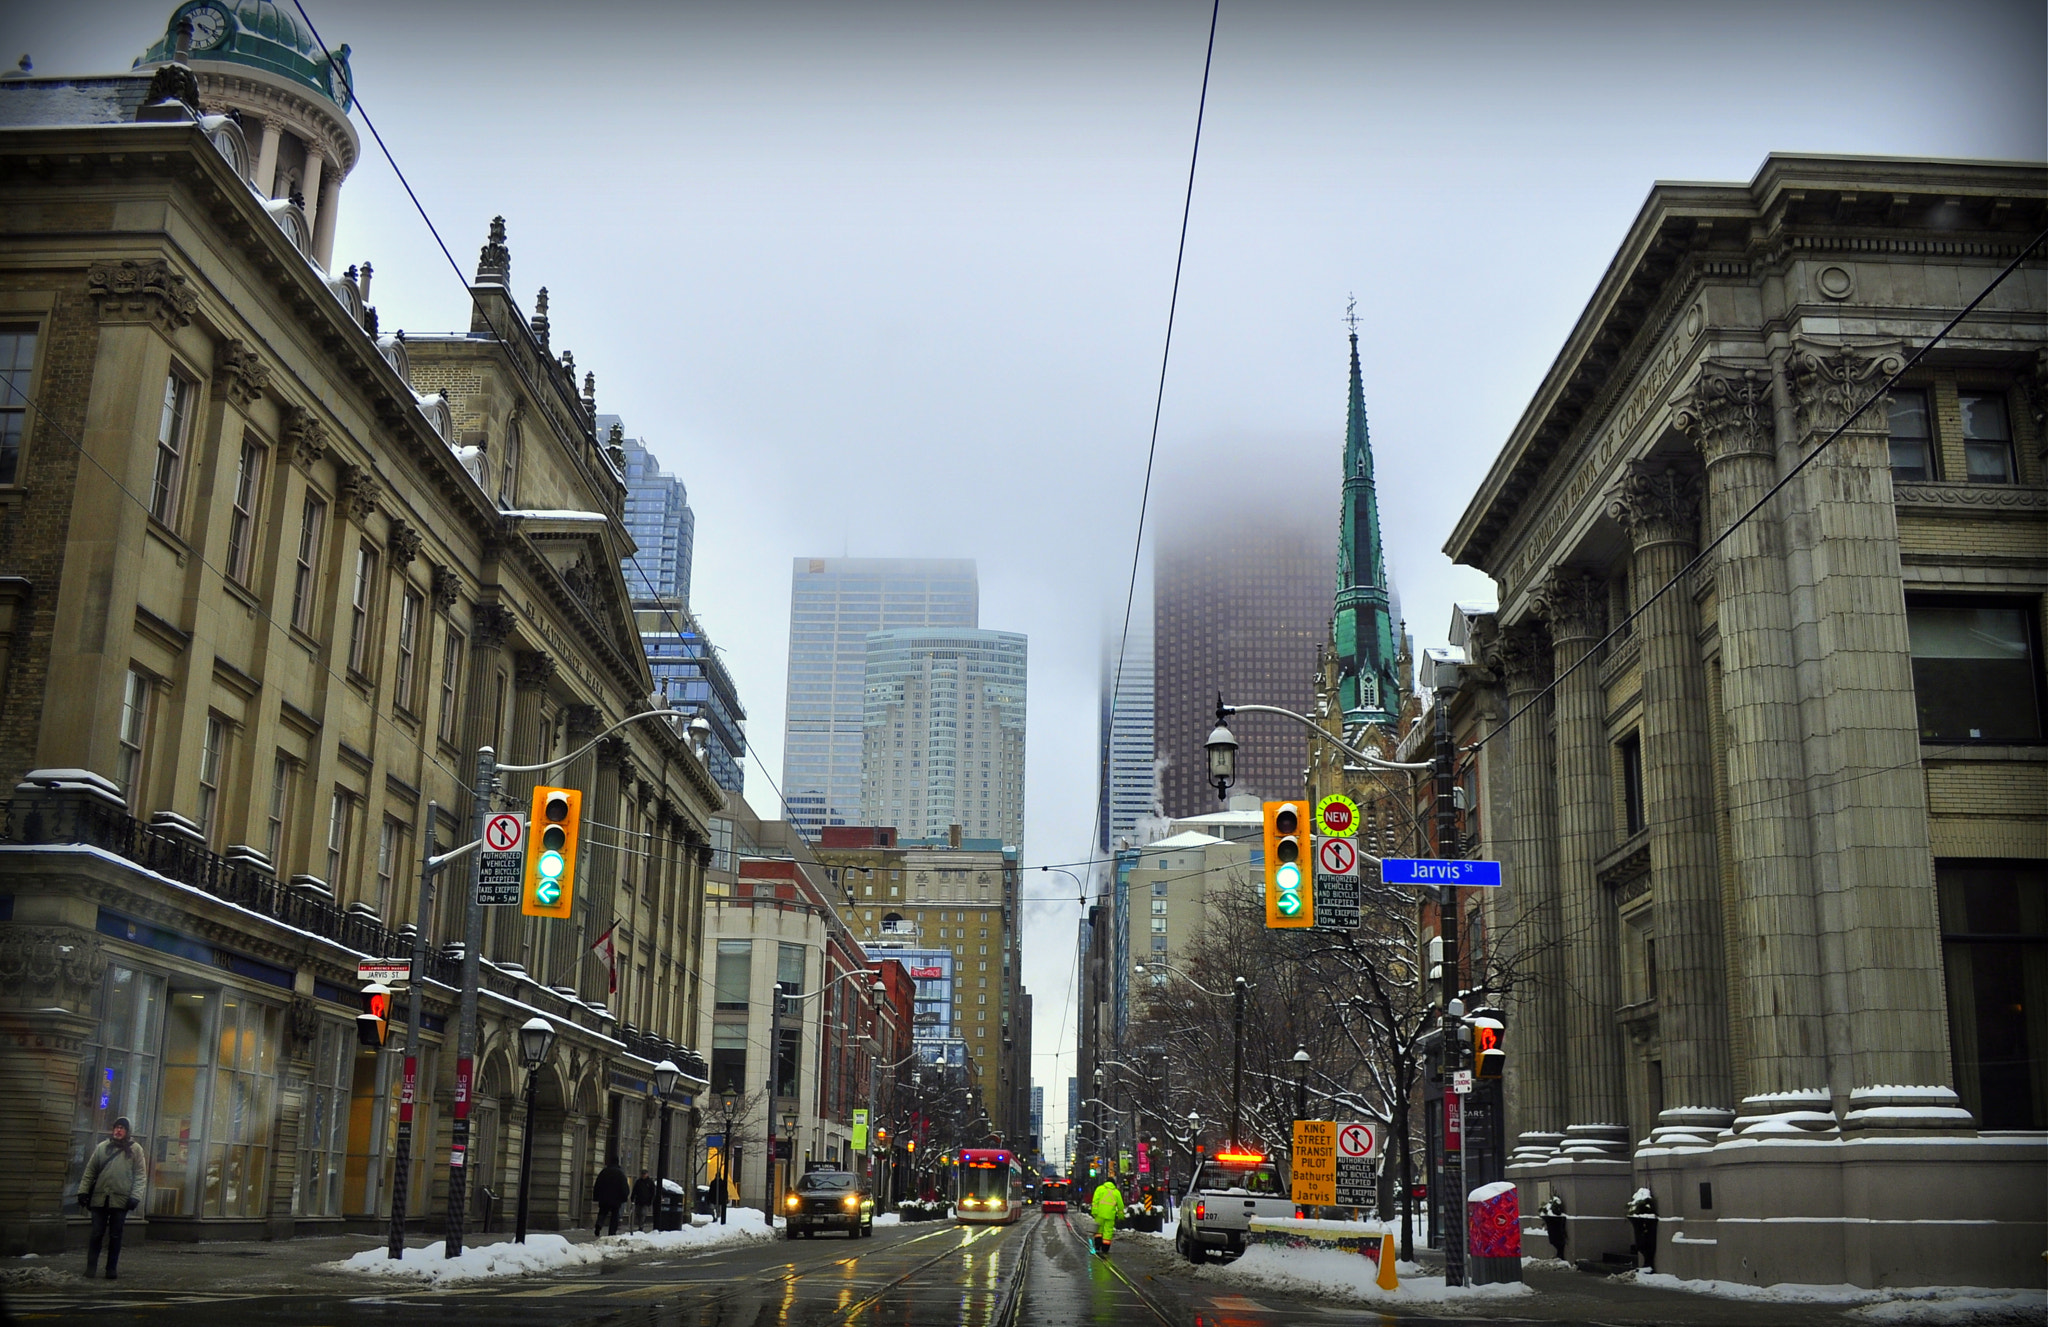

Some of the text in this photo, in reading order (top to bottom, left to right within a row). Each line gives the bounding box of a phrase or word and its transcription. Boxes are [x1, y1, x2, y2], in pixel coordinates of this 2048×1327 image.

[1510, 336, 1681, 587] THE CANADIAN BANK OF COMMERCE
[586, 669, 606, 704] HALL
[1325, 812, 1349, 823] NEW
[1411, 862, 1473, 879] Jarvis St
[1320, 875, 1358, 883] AUTHORIZED
[214, 950, 234, 970] RBC
[1304, 1124, 1325, 1134] KING
[1298, 1135, 1331, 1145] STREET
[1296, 1146, 1333, 1157] TRANSIT
[1302, 1158, 1326, 1168] PILOT
[1294, 1170, 1334, 1181] Bathurst
[1297, 1190, 1330, 1201] Jarvis
